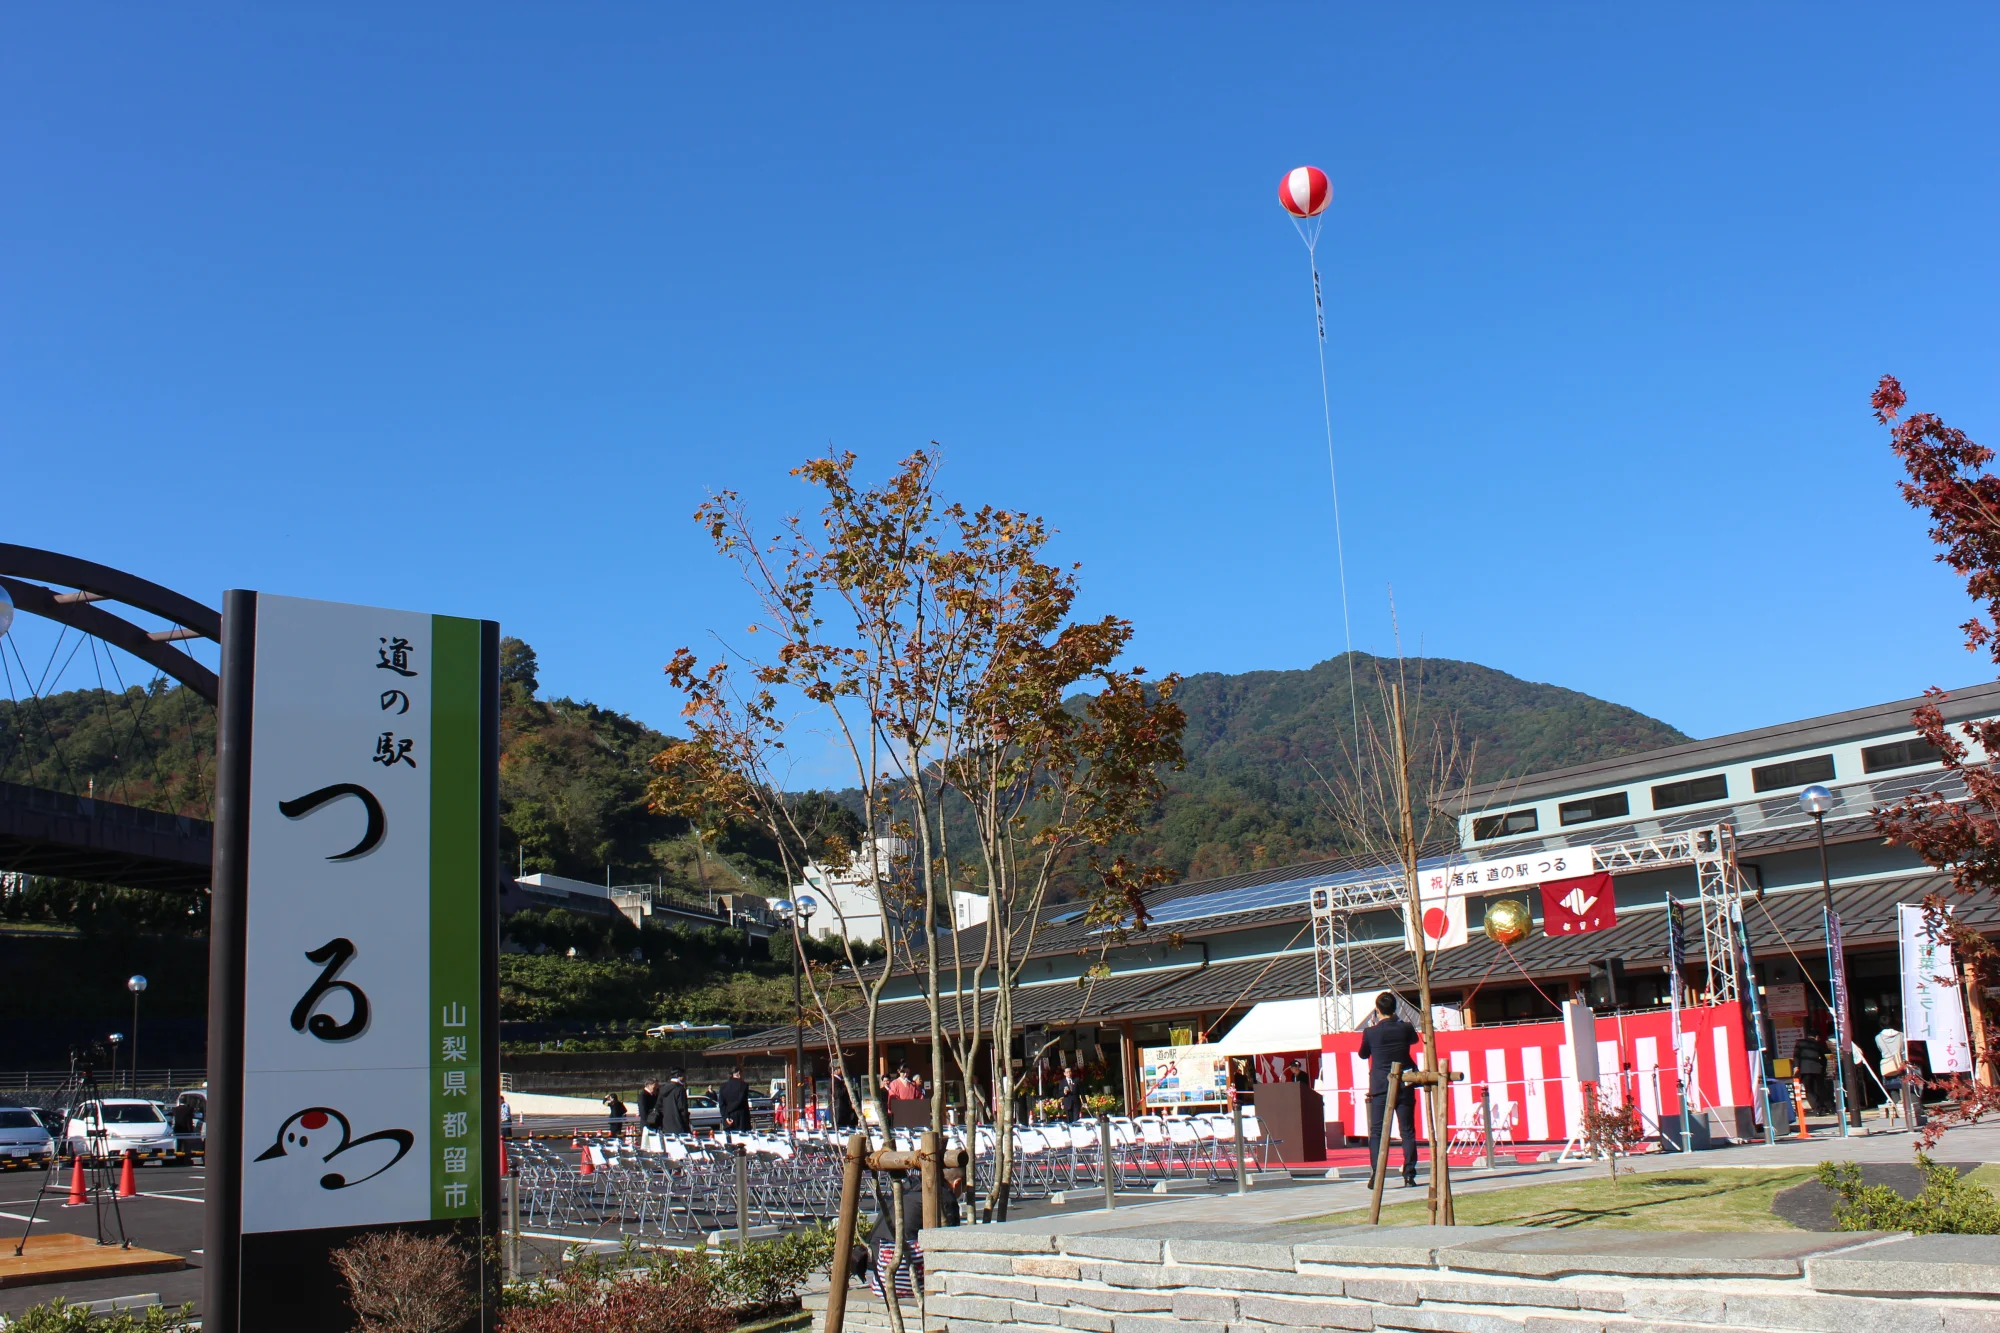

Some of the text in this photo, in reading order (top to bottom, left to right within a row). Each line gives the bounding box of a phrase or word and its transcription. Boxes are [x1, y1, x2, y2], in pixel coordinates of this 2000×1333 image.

[372, 636, 418, 768] 道の駅
[278, 783, 388, 1043] つる
[1430, 857, 1567, 890] 祝 落成 道の駅 つる
[1156, 1048, 1177, 1060] 道の駅
[1157, 1060, 1178, 1076] つる
[442, 1002, 468, 1208] 山梨県 都留市
